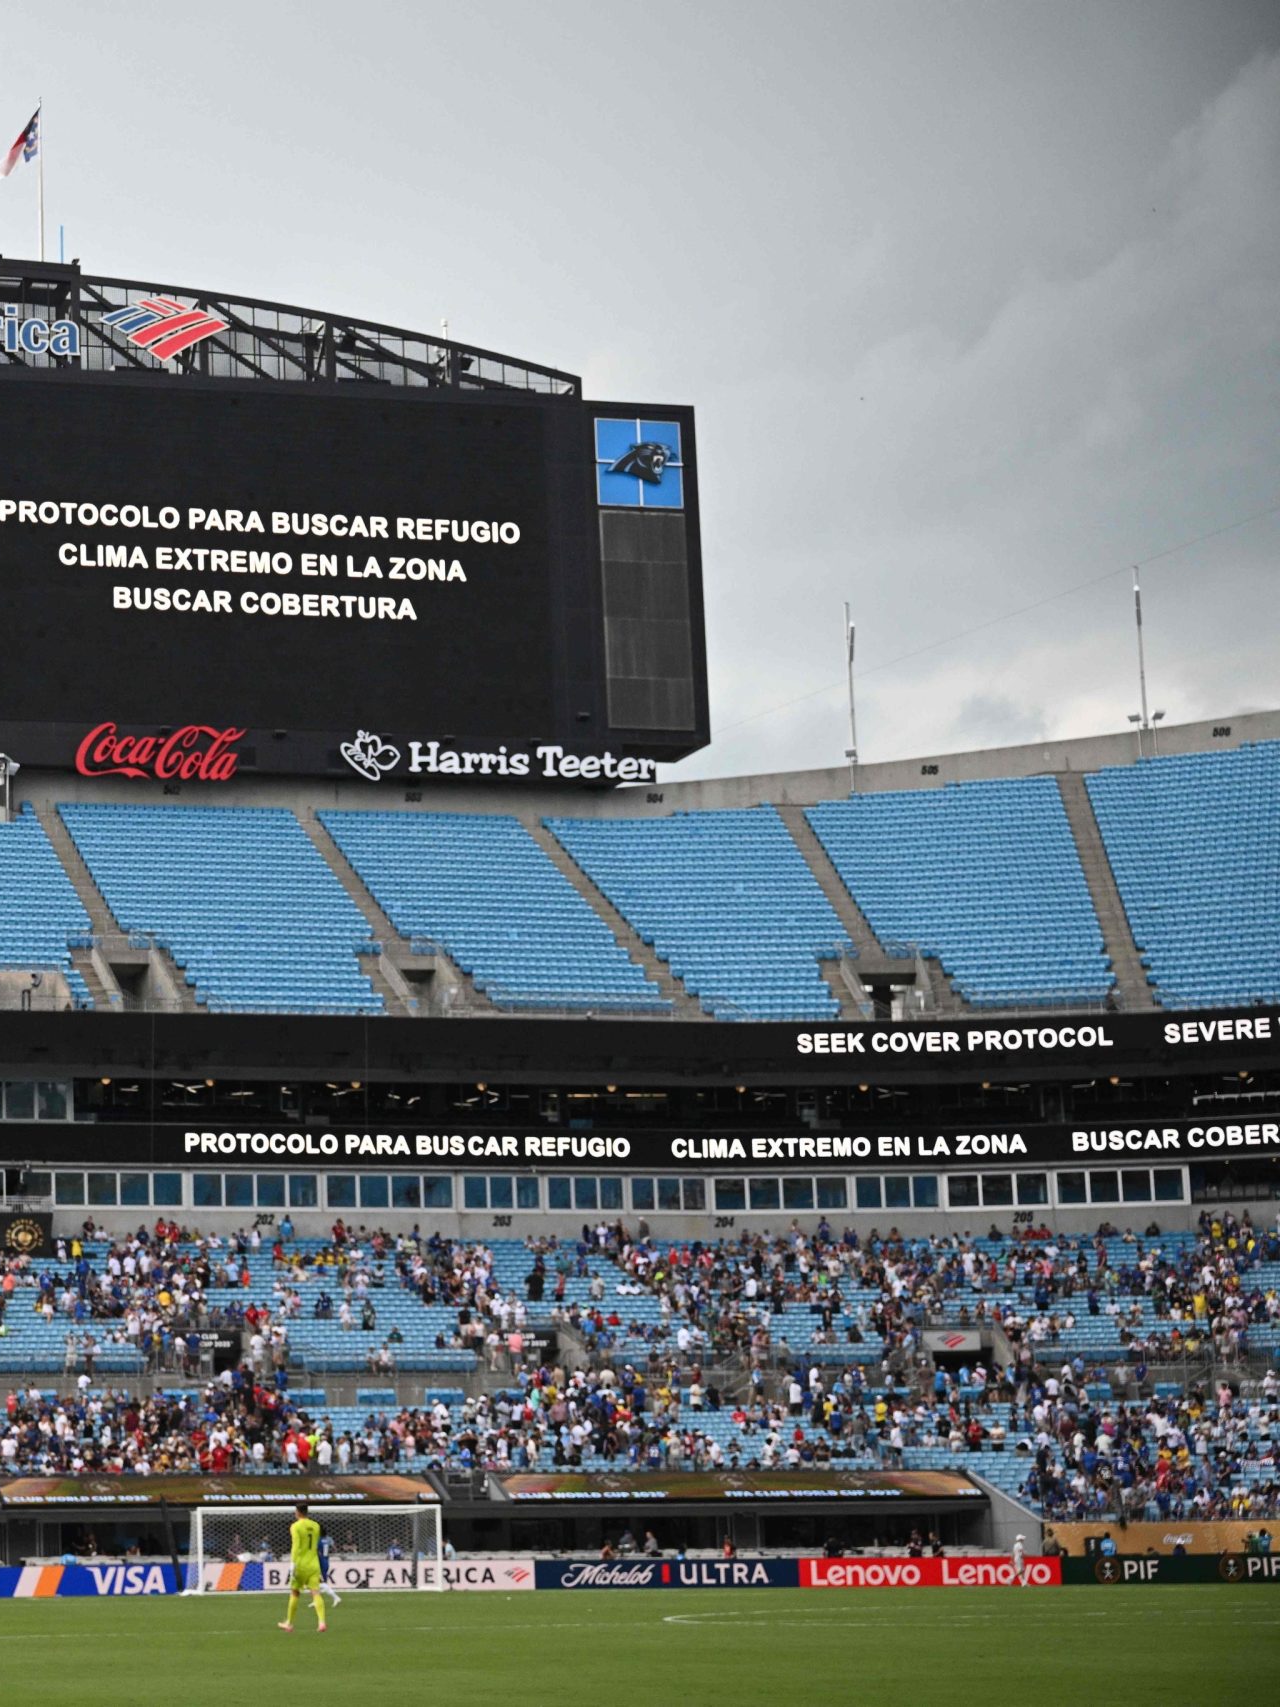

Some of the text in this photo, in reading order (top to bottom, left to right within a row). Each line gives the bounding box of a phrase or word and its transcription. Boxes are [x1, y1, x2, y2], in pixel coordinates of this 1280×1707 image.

[0, 500, 520, 544] PROTOCOLO PARA BUSCAR REFUGIO
[59, 543, 467, 582] CLIMA EXTREMO EN LA ZONA
[113, 586, 417, 620] BUSCAR COBERTURA
[76, 721, 246, 781] Coca-Cola
[408, 741, 656, 780] Harris Teeter
[797, 1027, 1113, 1053] SEEK COVER PROTOCOL
[1165, 1018, 1271, 1043] SEVERE
[185, 1133, 630, 1157] PROTOCOLO PARA BUSCAR REFUGIO
[671, 1134, 1027, 1158] CLIMA EXTREMO EN LA ZONA
[1072, 1129, 1180, 1151] BUSCAR
[256, 1213, 275, 1226] 202
[493, 1215, 512, 1228] 203
[714, 1216, 734, 1229] 204
[1013, 1211, 1033, 1224] 205
[307, 1534, 313, 1550] 1
[86, 1565, 166, 1595] VISA
[345, 1568, 374, 1584] OF
[561, 1562, 767, 1588] Michelob ULTRA
[810, 1560, 920, 1586] Lenovo
[1124, 1559, 1159, 1581] PIF
